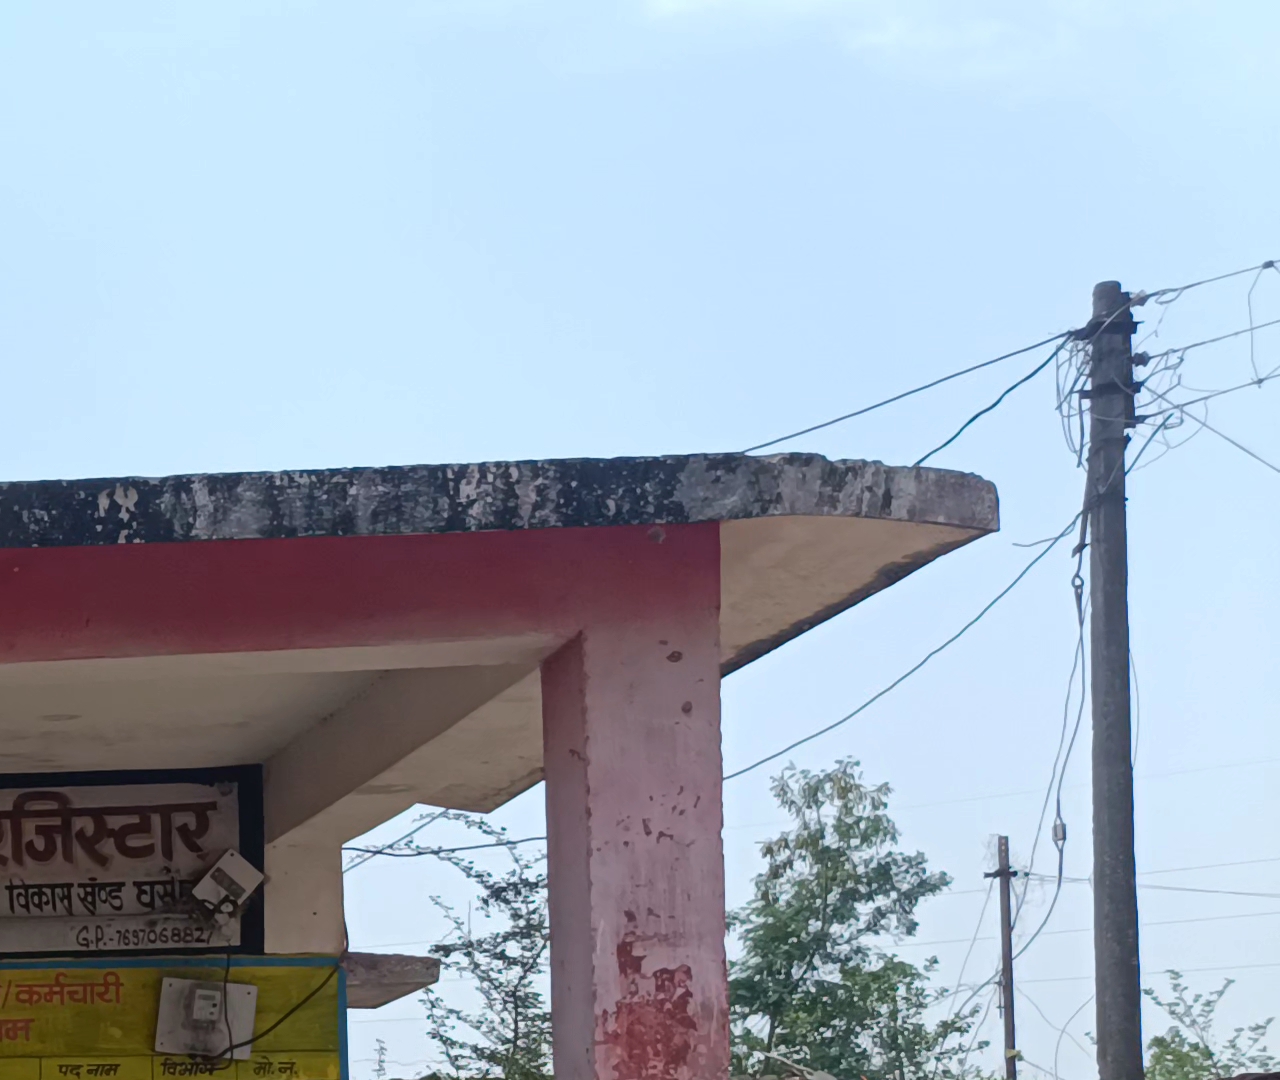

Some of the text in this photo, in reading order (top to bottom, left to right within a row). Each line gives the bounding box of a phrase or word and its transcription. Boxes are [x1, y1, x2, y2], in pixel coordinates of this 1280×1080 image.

[5, 878, 74, 916] विकास
[57, 1064, 83, 1079] पद
[86, 1064, 120, 1077] नाम
